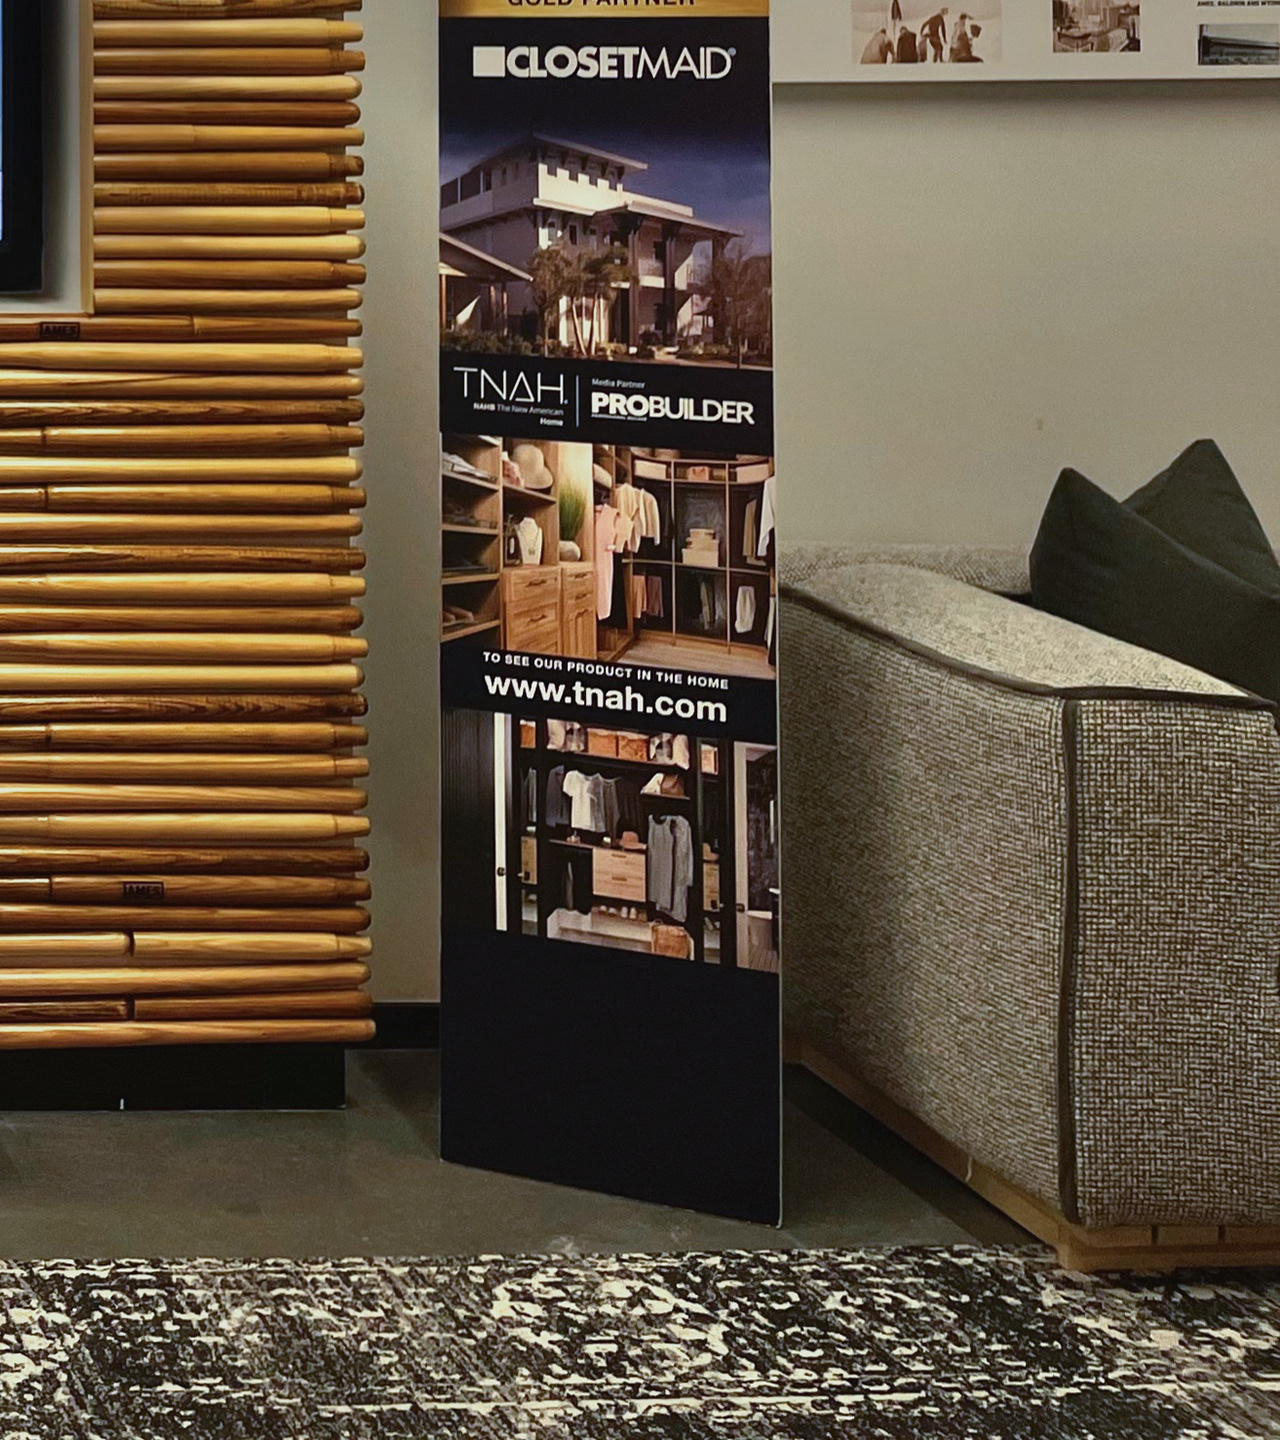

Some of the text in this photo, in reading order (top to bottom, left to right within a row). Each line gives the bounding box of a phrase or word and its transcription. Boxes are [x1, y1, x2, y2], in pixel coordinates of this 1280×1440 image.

[506, 46, 732, 79] CLOSETMAID
[43, 324, 78, 337] AMES
[453, 366, 565, 405] TNAH
[592, 378, 646, 389] Media Partner
[473, 402, 564, 416] NAHB The New American
[591, 392, 755, 425] PROBUILDER
[540, 417, 563, 427] Home
[483, 651, 729, 690] TO SEE OUR PRODUCT IN THE HOME
[484, 675, 727, 723] www.tnah.com
[126, 884, 162, 896] AMES
